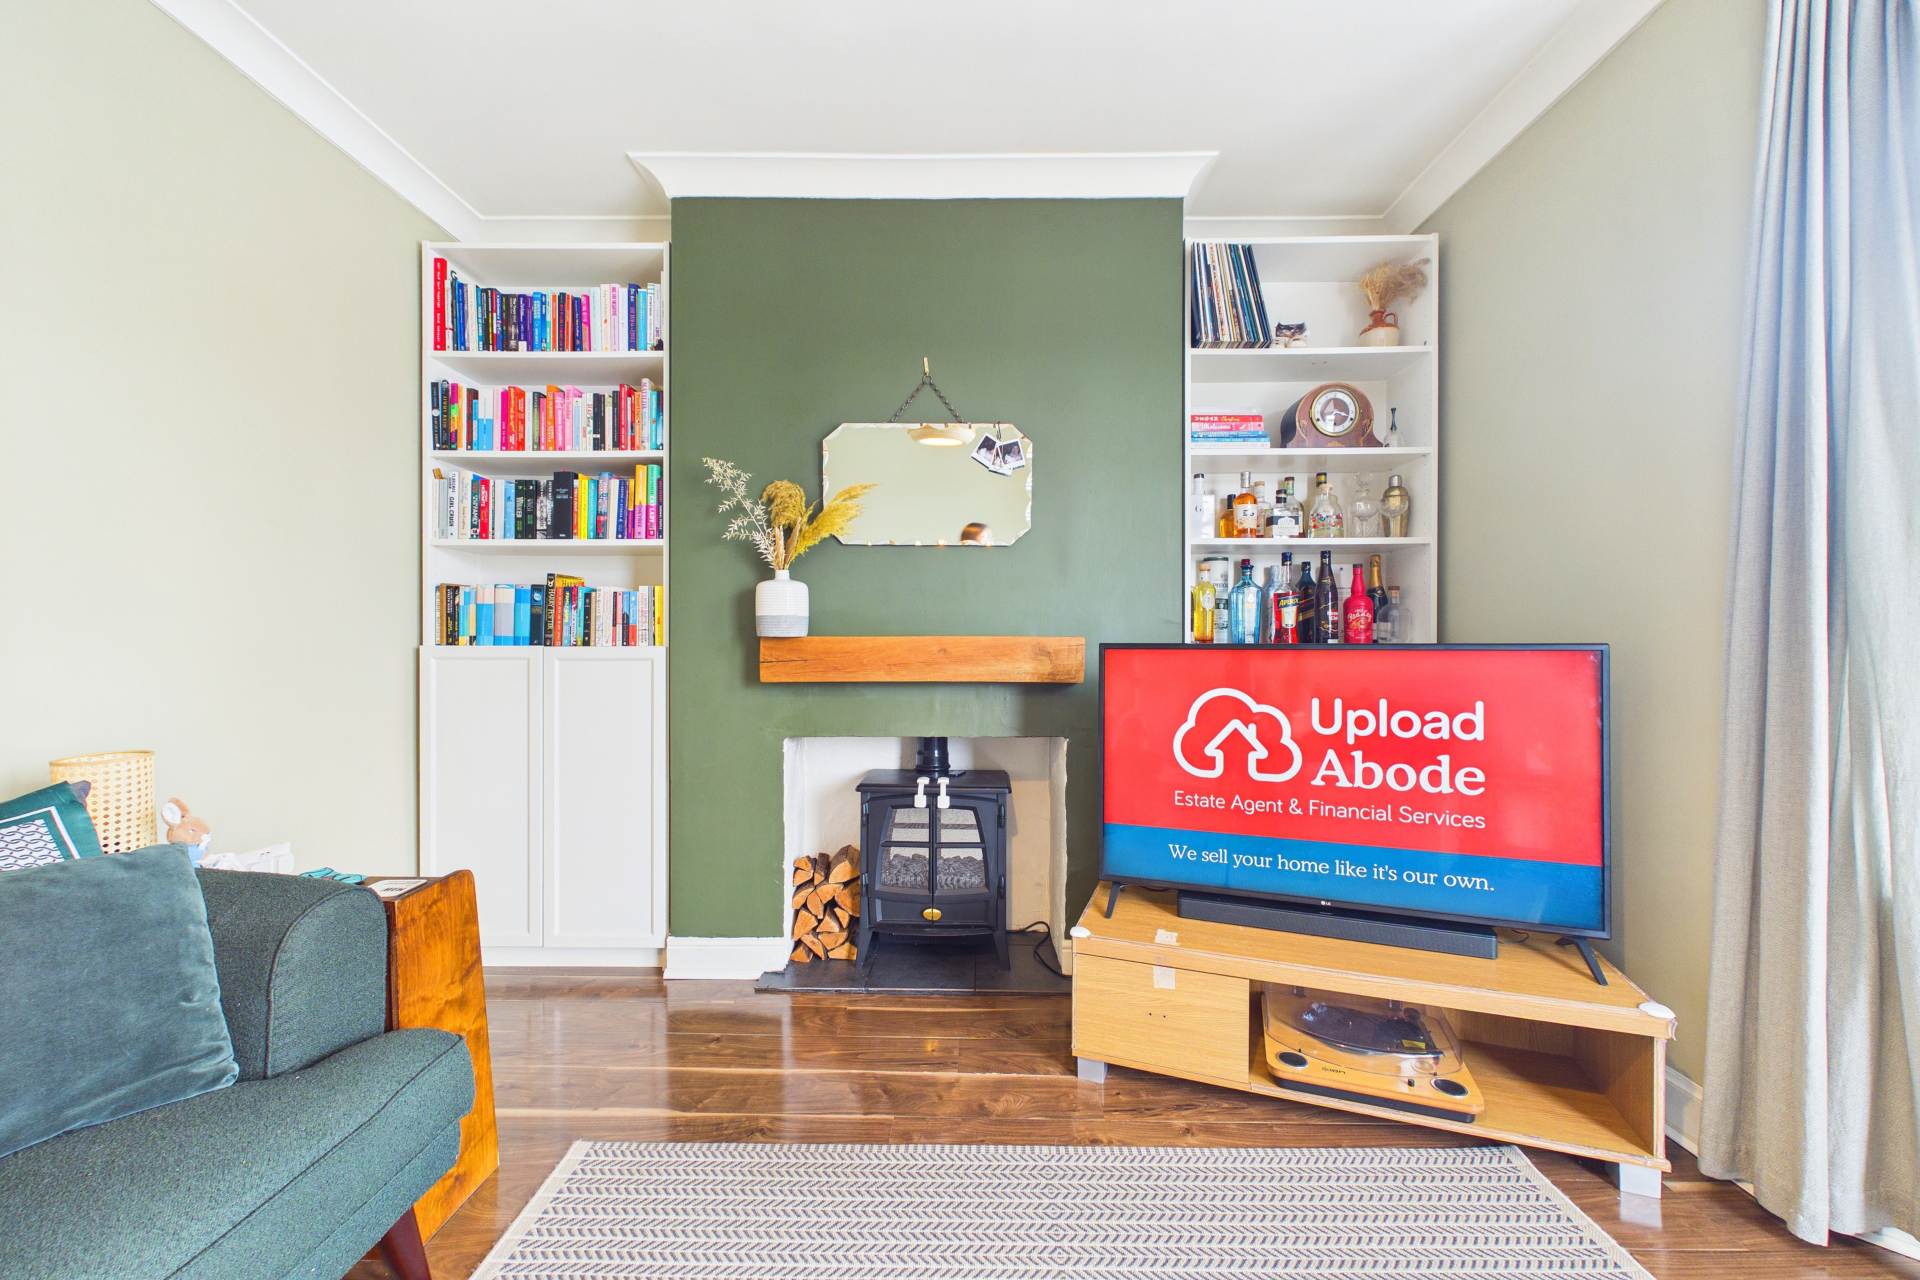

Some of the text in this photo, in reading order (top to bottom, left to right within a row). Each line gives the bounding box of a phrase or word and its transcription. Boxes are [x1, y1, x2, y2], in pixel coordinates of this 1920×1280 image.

[547, 608, 555, 630] POTTER
[1311, 697, 1485, 745] Upload
[1310, 749, 1486, 796] Abode
[1174, 790, 1486, 829] Estate Agent & Financial Services
[1169, 844, 1495, 891] We sell your home like it's our own.
